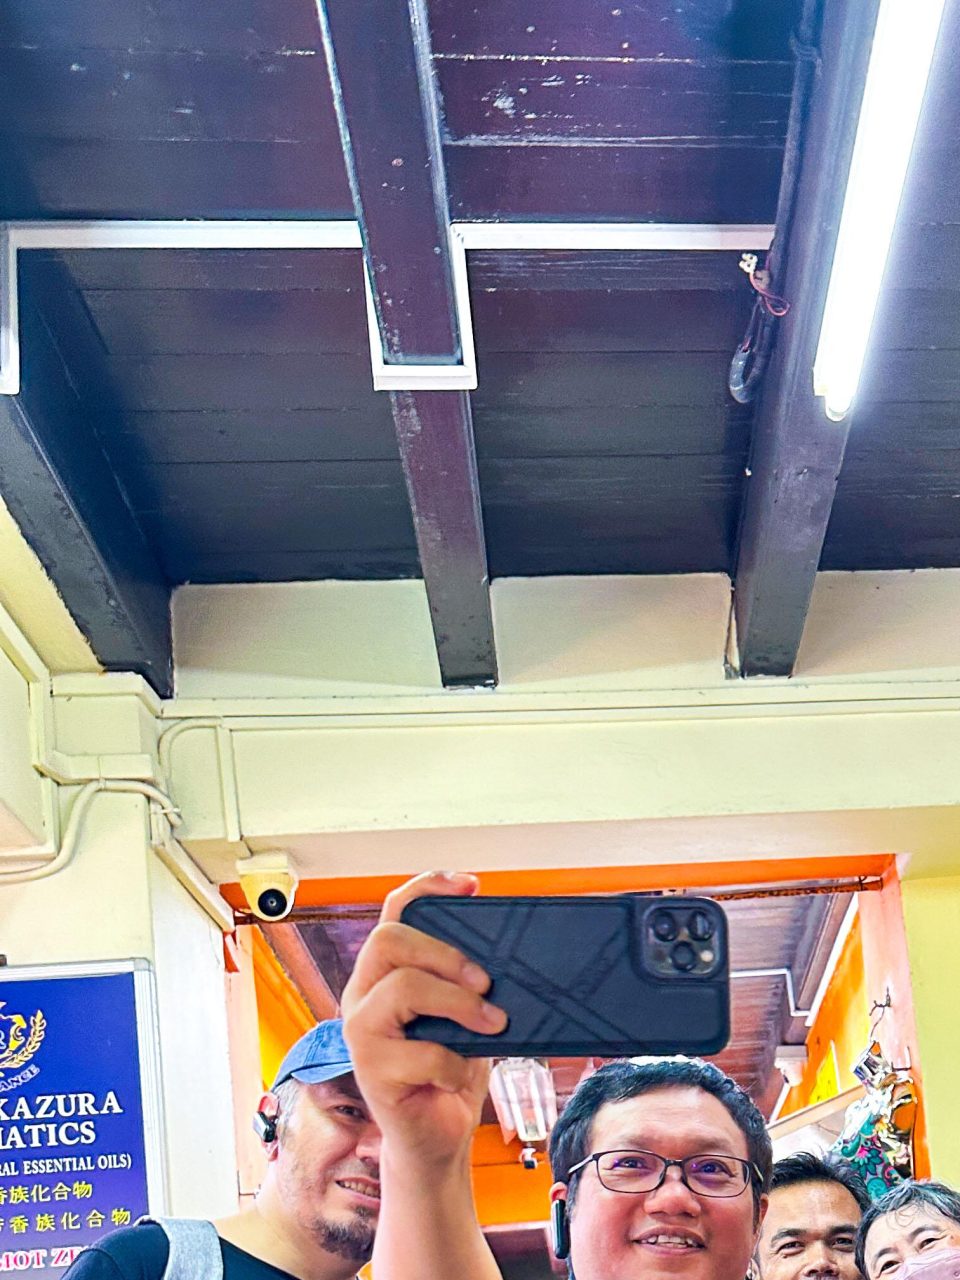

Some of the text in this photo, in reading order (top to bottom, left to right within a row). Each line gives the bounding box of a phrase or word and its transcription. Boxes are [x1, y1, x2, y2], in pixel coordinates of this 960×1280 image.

[0, 1120, 96, 1150] ATICS
[23, 1155, 95, 1175] ESSENTIAL
[97, 1153, 132, 1170] OILS)
[0, 1208, 132, 1234] 香族化合物
